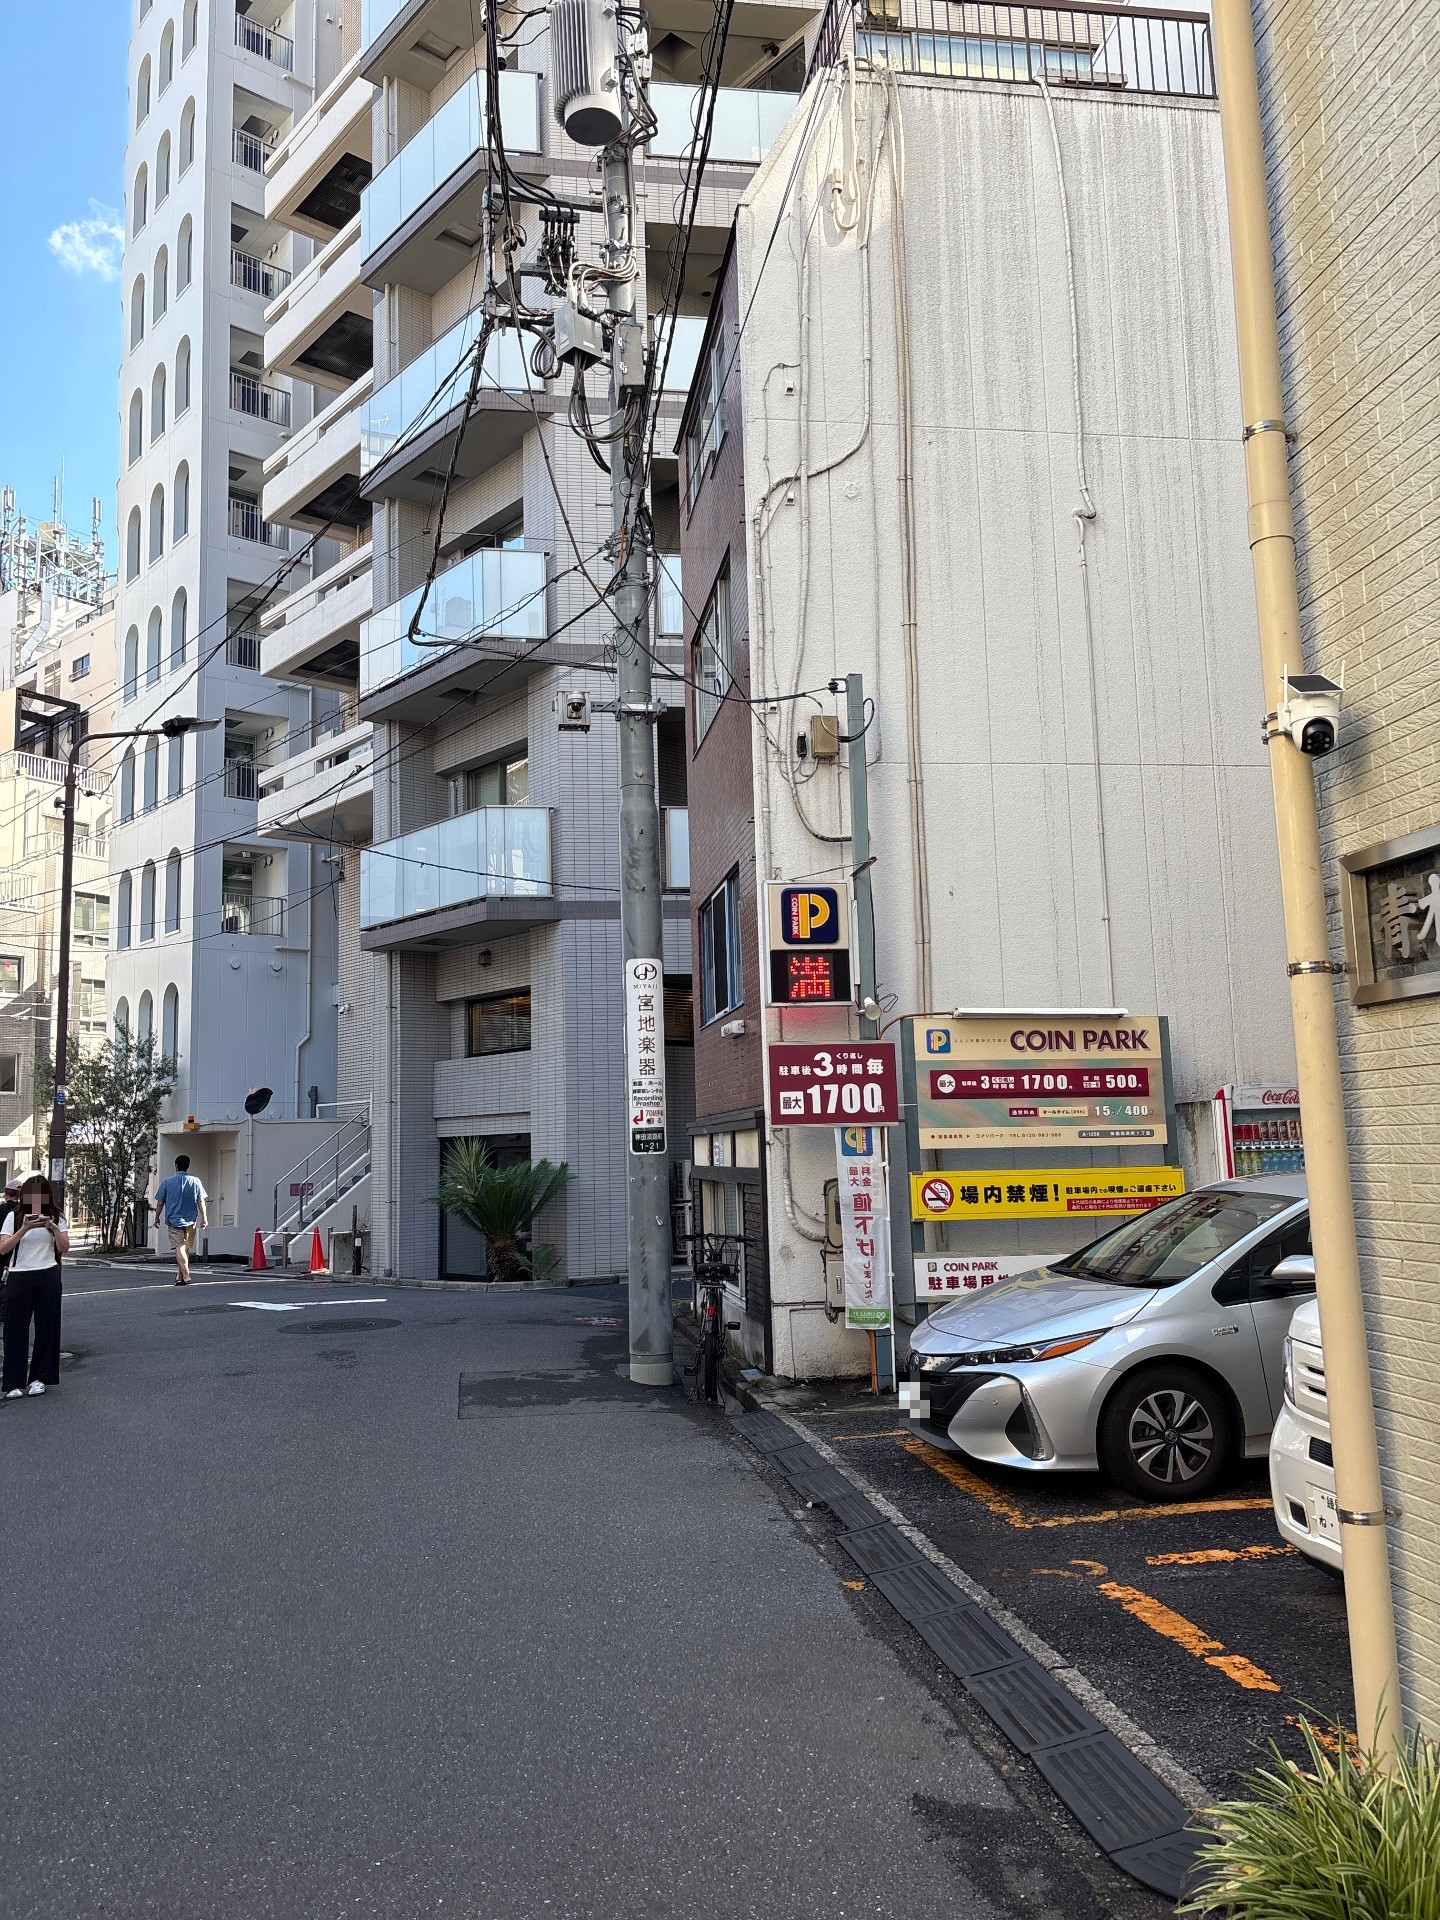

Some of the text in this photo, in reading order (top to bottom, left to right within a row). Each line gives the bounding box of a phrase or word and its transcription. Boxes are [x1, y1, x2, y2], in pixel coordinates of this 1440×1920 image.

[790, 957, 831, 998] 満
[637, 994, 656, 1076] 宮地楽器
[1010, 1029, 1151, 1051] COIN PARK
[836, 1052, 864, 1060] くり返し
[938, 1079, 955, 1089] 最大
[782, 1096, 802, 1111] 最大
[639, 1142, 659, 1150] 1-21
[960, 1184, 1060, 1204] 場内禁煙!
[944, 1262, 998, 1272] COIN PARK
[928, 1273, 1009, 1291] 駐車場用
